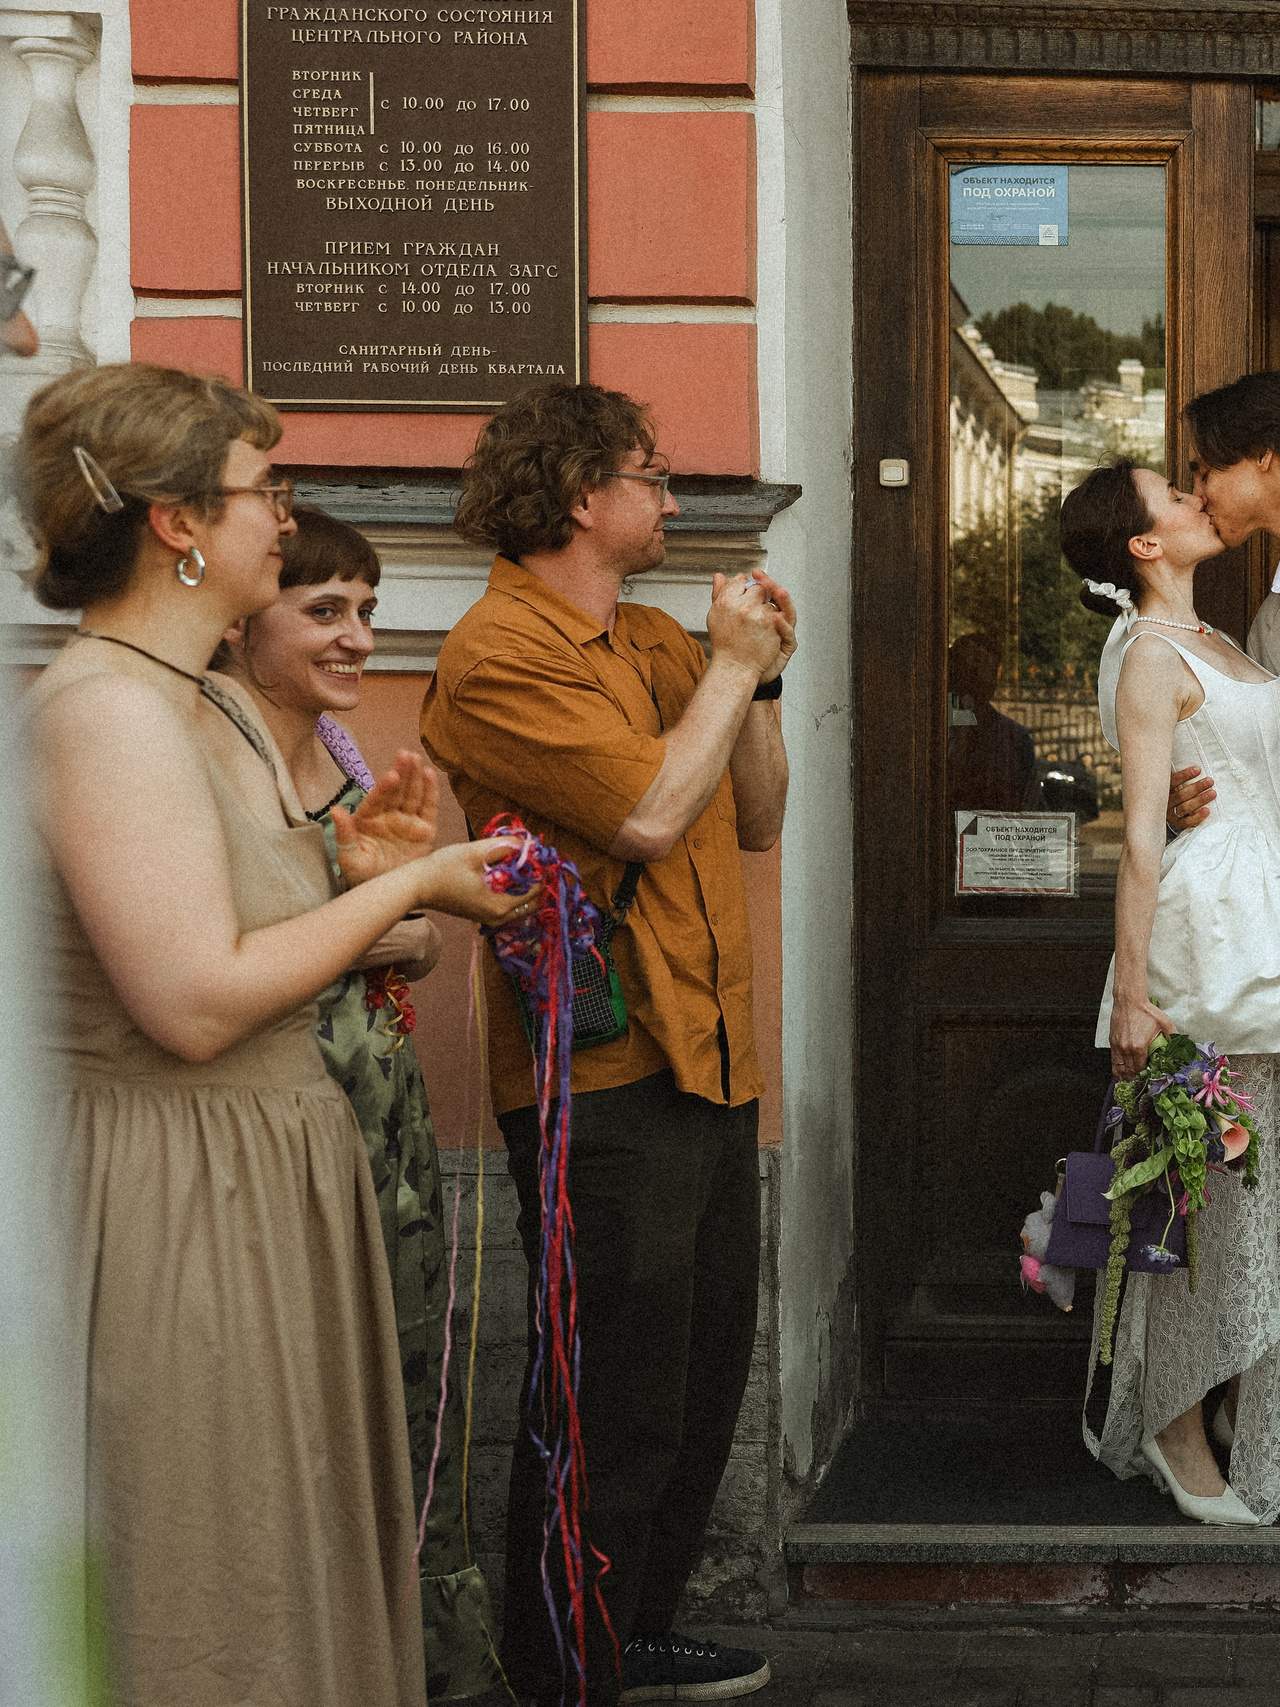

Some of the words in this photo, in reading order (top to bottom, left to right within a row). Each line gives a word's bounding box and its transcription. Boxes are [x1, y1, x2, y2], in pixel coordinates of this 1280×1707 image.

[268, 7, 427, 23] ГРАЖДАНСКОГО
[438, 10, 553, 23] СОСТОЯНИЯ
[292, 29, 441, 44] ЦЕНТРАЛЬНОГО
[455, 29, 528, 45] РАЙОНА
[293, 71, 362, 81] ВТОРНИК
[293, 89, 342, 100] СРЕДА
[403, 97, 444, 110] 10.00
[488, 98, 530, 111] 17.00
[293, 107, 359, 117] ЧЕТВЕРГ
[294, 124, 365, 136] ПЯТНИЦА
[294, 143, 363, 153] СУББОТА
[401, 141, 442, 154] 10.00
[488, 142, 530, 154] 16.00
[294, 161, 365, 171] ПЕРЕРЫВ
[401, 159, 442, 172] 13.00
[488, 161, 530, 173] 14.00
[1001, 177, 1055, 185] НАХОДИТСЯ
[963, 188, 991, 198] ПОД
[995, 186, 1055, 197] ОХРАНОЙ
[326, 195, 432, 213] ВЫХОДНОЙ
[444, 198, 494, 213] ДЕНЬ
[325, 242, 391, 255] ПРИЕМ
[403, 242, 500, 257] ГРАЖДАН
[267, 262, 410, 276] НАЧАЛЬНИКОМ
[421, 264, 497, 278] ОТДЕЛА
[509, 264, 558, 278] ЗАГС
[296, 284, 365, 294] ВТОРНИК
[402, 282, 440, 295] 14.00
[489, 283, 530, 295] 17.00
[295, 302, 360, 312] ЧЕТВЕРГ
[402, 301, 440, 313] 10.00
[489, 301, 531, 314] 13.00
[339, 344, 442, 356] САНИТАРНЫЙ
[263, 360, 353, 373] ПОСЛЕДНИЙ
[363, 361, 430, 373] РАБОЧИЙ
[438, 364, 478, 375] ДЕНЬ
[488, 364, 565, 375] КВАРТАЛА
